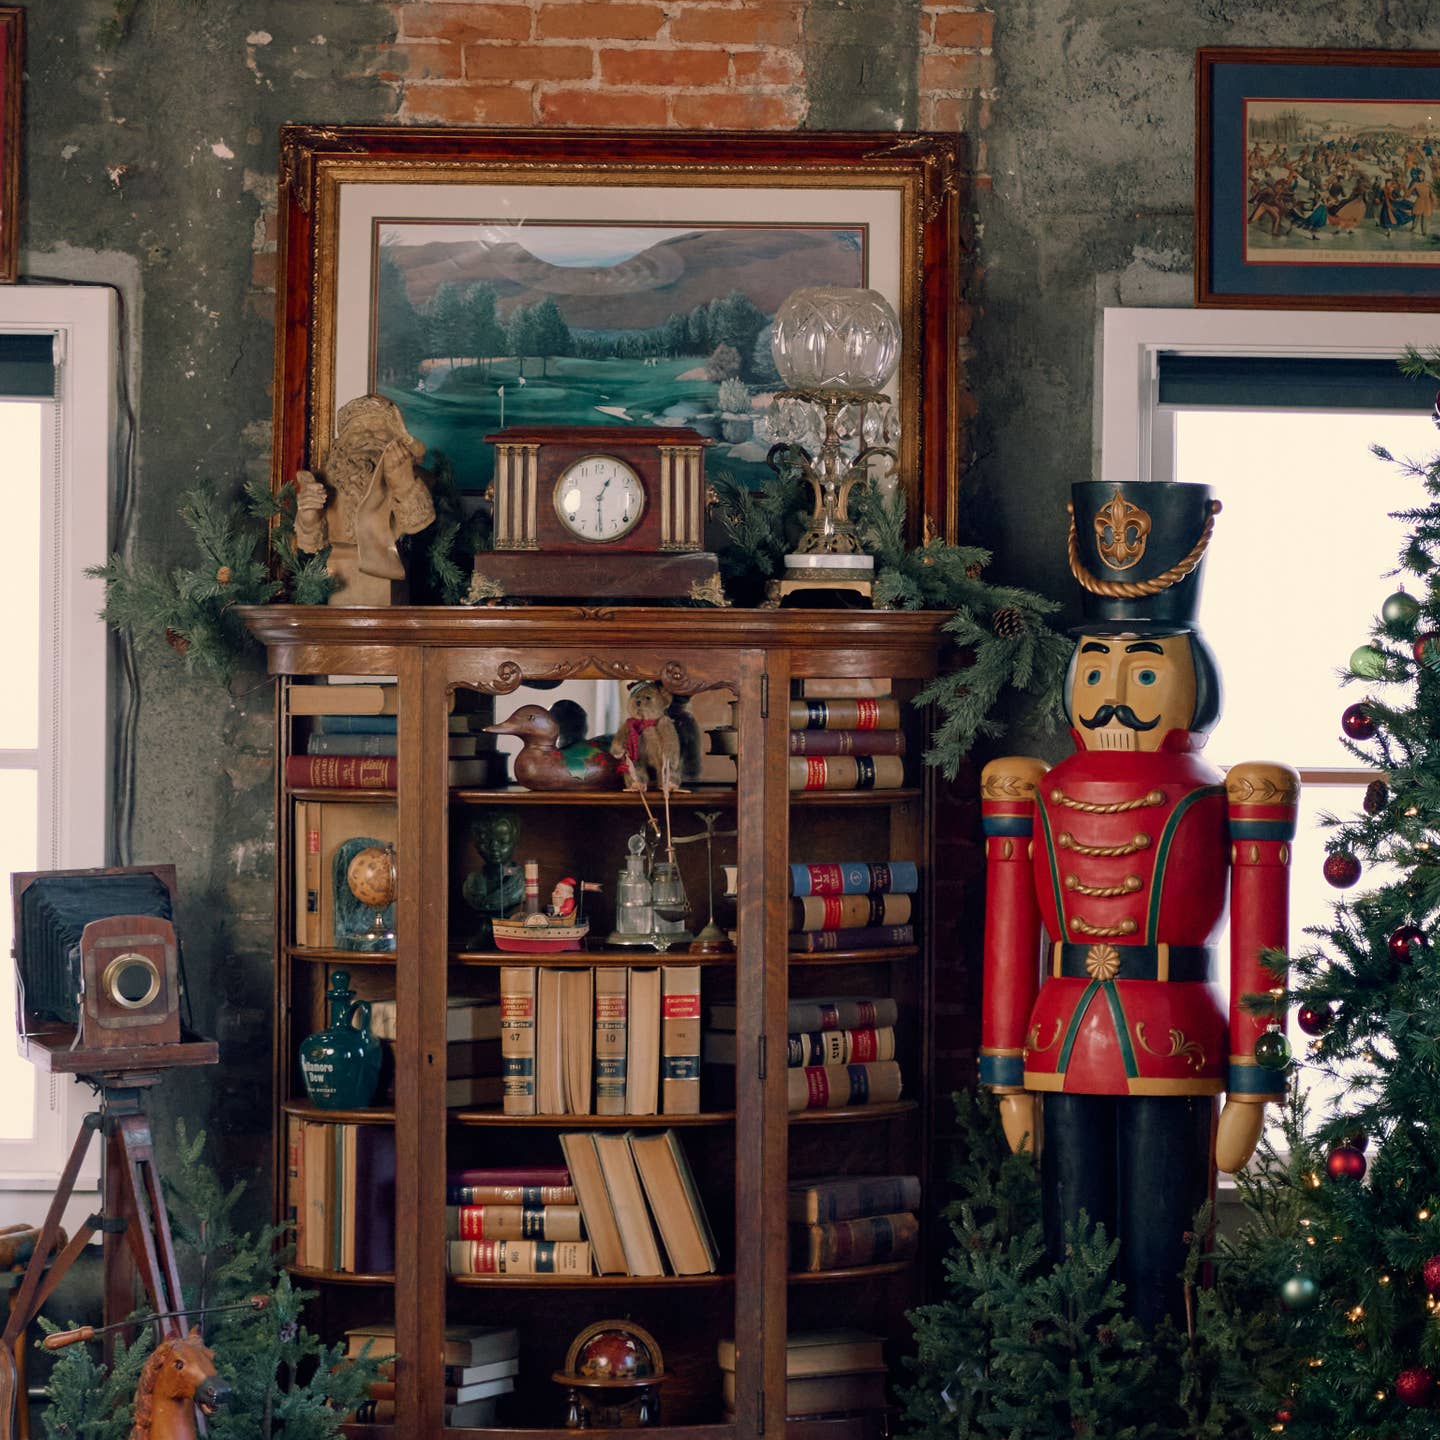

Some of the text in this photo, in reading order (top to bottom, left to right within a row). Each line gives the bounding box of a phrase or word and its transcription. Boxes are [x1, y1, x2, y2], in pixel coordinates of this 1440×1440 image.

[581, 467, 588, 477] 11
[595, 464, 605, 474] 12
[623, 478, 630, 488] 2
[510, 1033, 520, 1041] 47
[605, 1034, 616, 1043] 10
